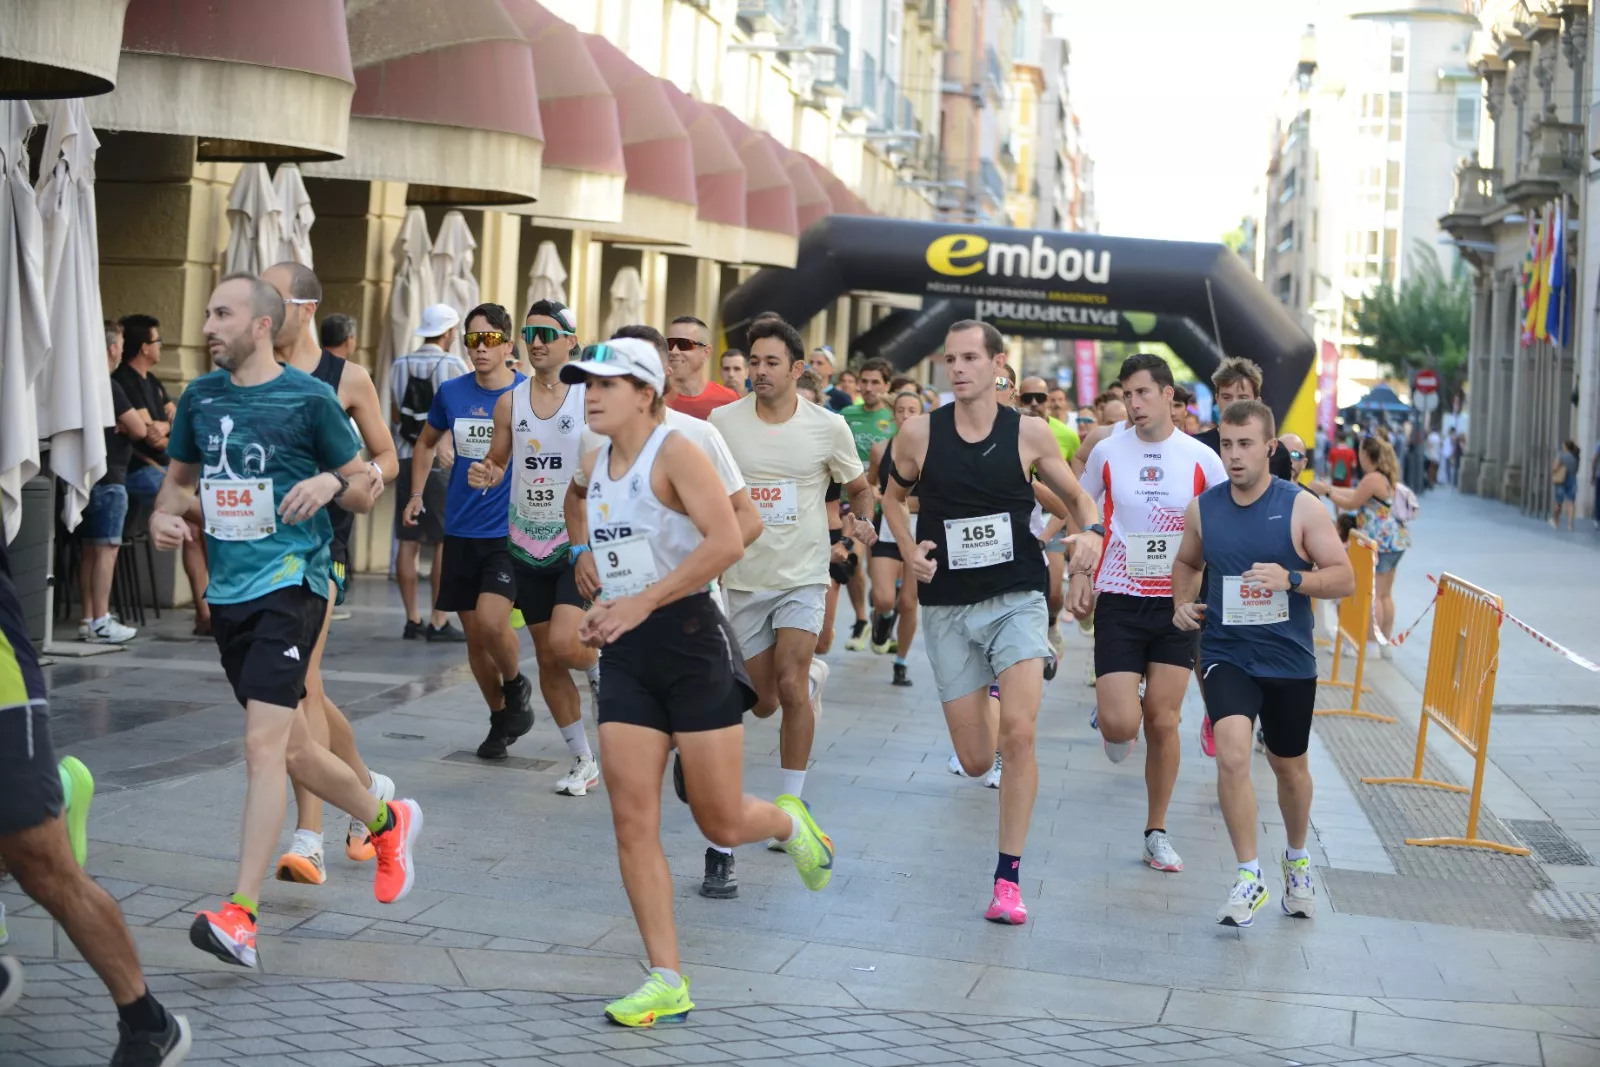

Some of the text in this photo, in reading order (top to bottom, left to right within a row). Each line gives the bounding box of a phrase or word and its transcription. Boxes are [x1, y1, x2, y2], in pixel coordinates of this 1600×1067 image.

[925, 233, 1112, 284] embou
[468, 425, 494, 439] 109
[525, 456, 563, 470] SYB
[216, 489, 253, 507] 554
[526, 489, 555, 501] 133
[750, 487, 782, 501] 502
[217, 509, 254, 517] CHRISTIAN
[962, 524, 996, 542] 165
[962, 539, 999, 549] FRANCISCO
[1146, 539, 1167, 553] 23
[607, 551, 619, 568] 9
[606, 569, 632, 579] ANDREA
